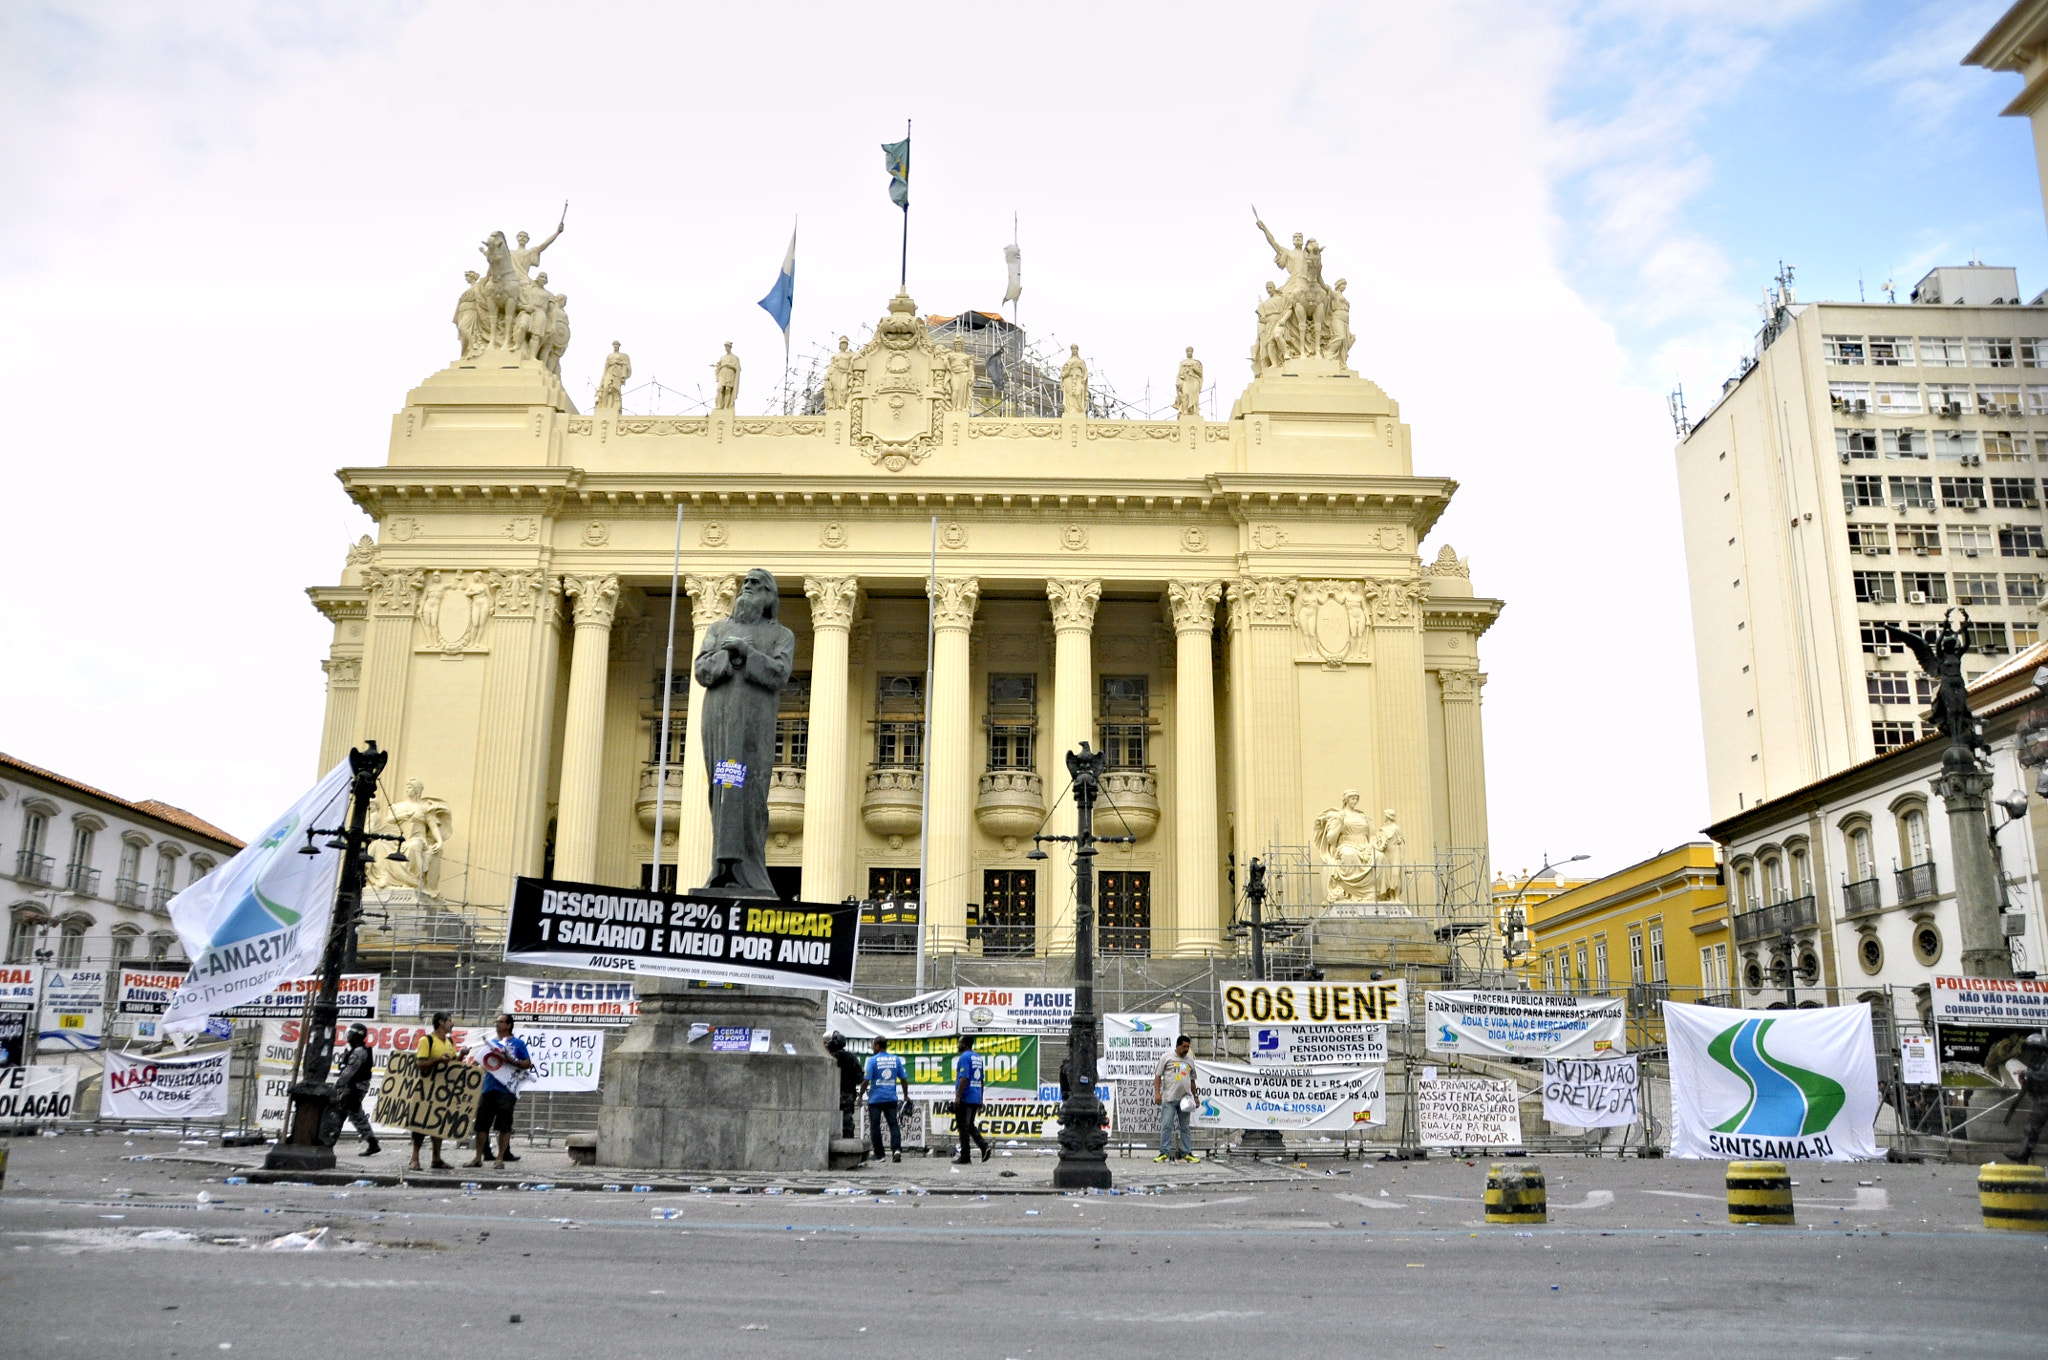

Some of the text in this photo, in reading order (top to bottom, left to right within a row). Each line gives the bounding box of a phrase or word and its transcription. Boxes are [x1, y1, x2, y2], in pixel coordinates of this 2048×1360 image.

[541, 889, 833, 938] DESCONTAR 22% É ROUBAR
[538, 918, 830, 965] 1 SALÁRIO E MEIO POR ANO!
[588, 956, 636, 970] MUSPE
[640, 963, 666, 972] MOVIMENTO
[667, 966, 690, 974] UNIFICADO
[72, 973, 101, 981] ASFIA
[124, 974, 186, 989] POLICIA
[531, 981, 640, 1000] EXIGIM
[1936, 977, 2018, 992] POLICIAIS
[13, 987, 34, 997] RAS
[127, 988, 169, 1003] Ativos,
[964, 989, 1072, 1008] PEZÃO! PAGUE
[1959, 991, 2040, 1005] NÃO VÃO PAGAR
[265, 995, 273, 1005] e
[514, 999, 624, 1015] Salário em dia,
[1225, 984, 1399, 1022] S.O.S. UENF
[1473, 994, 1578, 1007] PARCERIA PÚBLICA PRIVADA
[126, 1003, 154, 1012] SINPOL
[265, 1008, 289, 1017] CIVIS
[863, 1004, 884, 1020] VIDA,
[887, 1007, 892, 1018] A
[894, 1003, 919, 1018] CEDAE
[928, 999, 956, 1015] NOSSA!
[1007, 1008, 1073, 1018] INCORPORAÇÃO DA
[1428, 1000, 1622, 1019] É DAR DINHEIRO PÚBLICO PARA EMPRESAS PRIVADAS
[1945, 1004, 2019, 1016] CORRUPÇÃO DO
[905, 1020, 954, 1033] SEPE RJ
[1291, 1026, 1306, 1034] NA
[1309, 1026, 1335, 1034] LUTA
[1337, 1025, 1362, 1033] COM
[1462, 1014, 1589, 1031] ÁGUA É VIDA, NÃO É MERCADORIA!
[552, 1037, 562, 1047] O
[570, 1036, 597, 1049] MEU
[1109, 1037, 1172, 1048] SINTSAMA PRESENTE NA LUTA
[1297, 1034, 1374, 1043] SERVIDORES E
[1488, 1030, 1561, 1042] DIGA NÃO AS PPP'S!
[886, 1036, 1020, 1057] 2018 TEM EIÇÃO!
[1290, 1043, 1383, 1053] PENSIONISTAS DO
[204, 1058, 223, 1068] DIZ
[1119, 1051, 1135, 1061] BRASIL
[1135, 1051, 1151, 1062] SEGUIR
[1293, 1053, 1366, 1063] ESTADO DO RJ
[915, 1056, 943, 1083] DE
[1107, 1064, 1124, 1075] CONTRA
[1259, 1068, 1313, 1077] COMPAREM!
[1604, 1063, 1636, 1084] NÃO
[111, 1064, 158, 1091] NÃO
[1209, 1075, 1252, 1086] GARRAFA
[1254, 1075, 1288, 1087] D'ÁGUA
[1290, 1079, 1303, 1087] DE
[1343, 1080, 1362, 1090] 4,00
[139, 1090, 153, 1101] DA
[157, 1090, 191, 1101] CEDAE
[382, 1076, 465, 1106] O MAIOR
[1214, 1088, 1247, 1097] LITROS
[1250, 1090, 1262, 1098] DE
[1265, 1089, 1290, 1099] ÁGUA
[1292, 1092, 1305, 1100] DA
[1308, 1092, 1338, 1100] CEDAE
[1546, 1082, 1607, 1112] GREVE
[977, 1101, 1063, 1120] PRIVATIZAÇÃ
[1246, 1102, 1326, 1113] A ÁGUA É NOSSA!
[978, 1121, 1044, 1135] CEDAE
[1709, 1134, 1834, 1159] SINTSAMA-RJ
